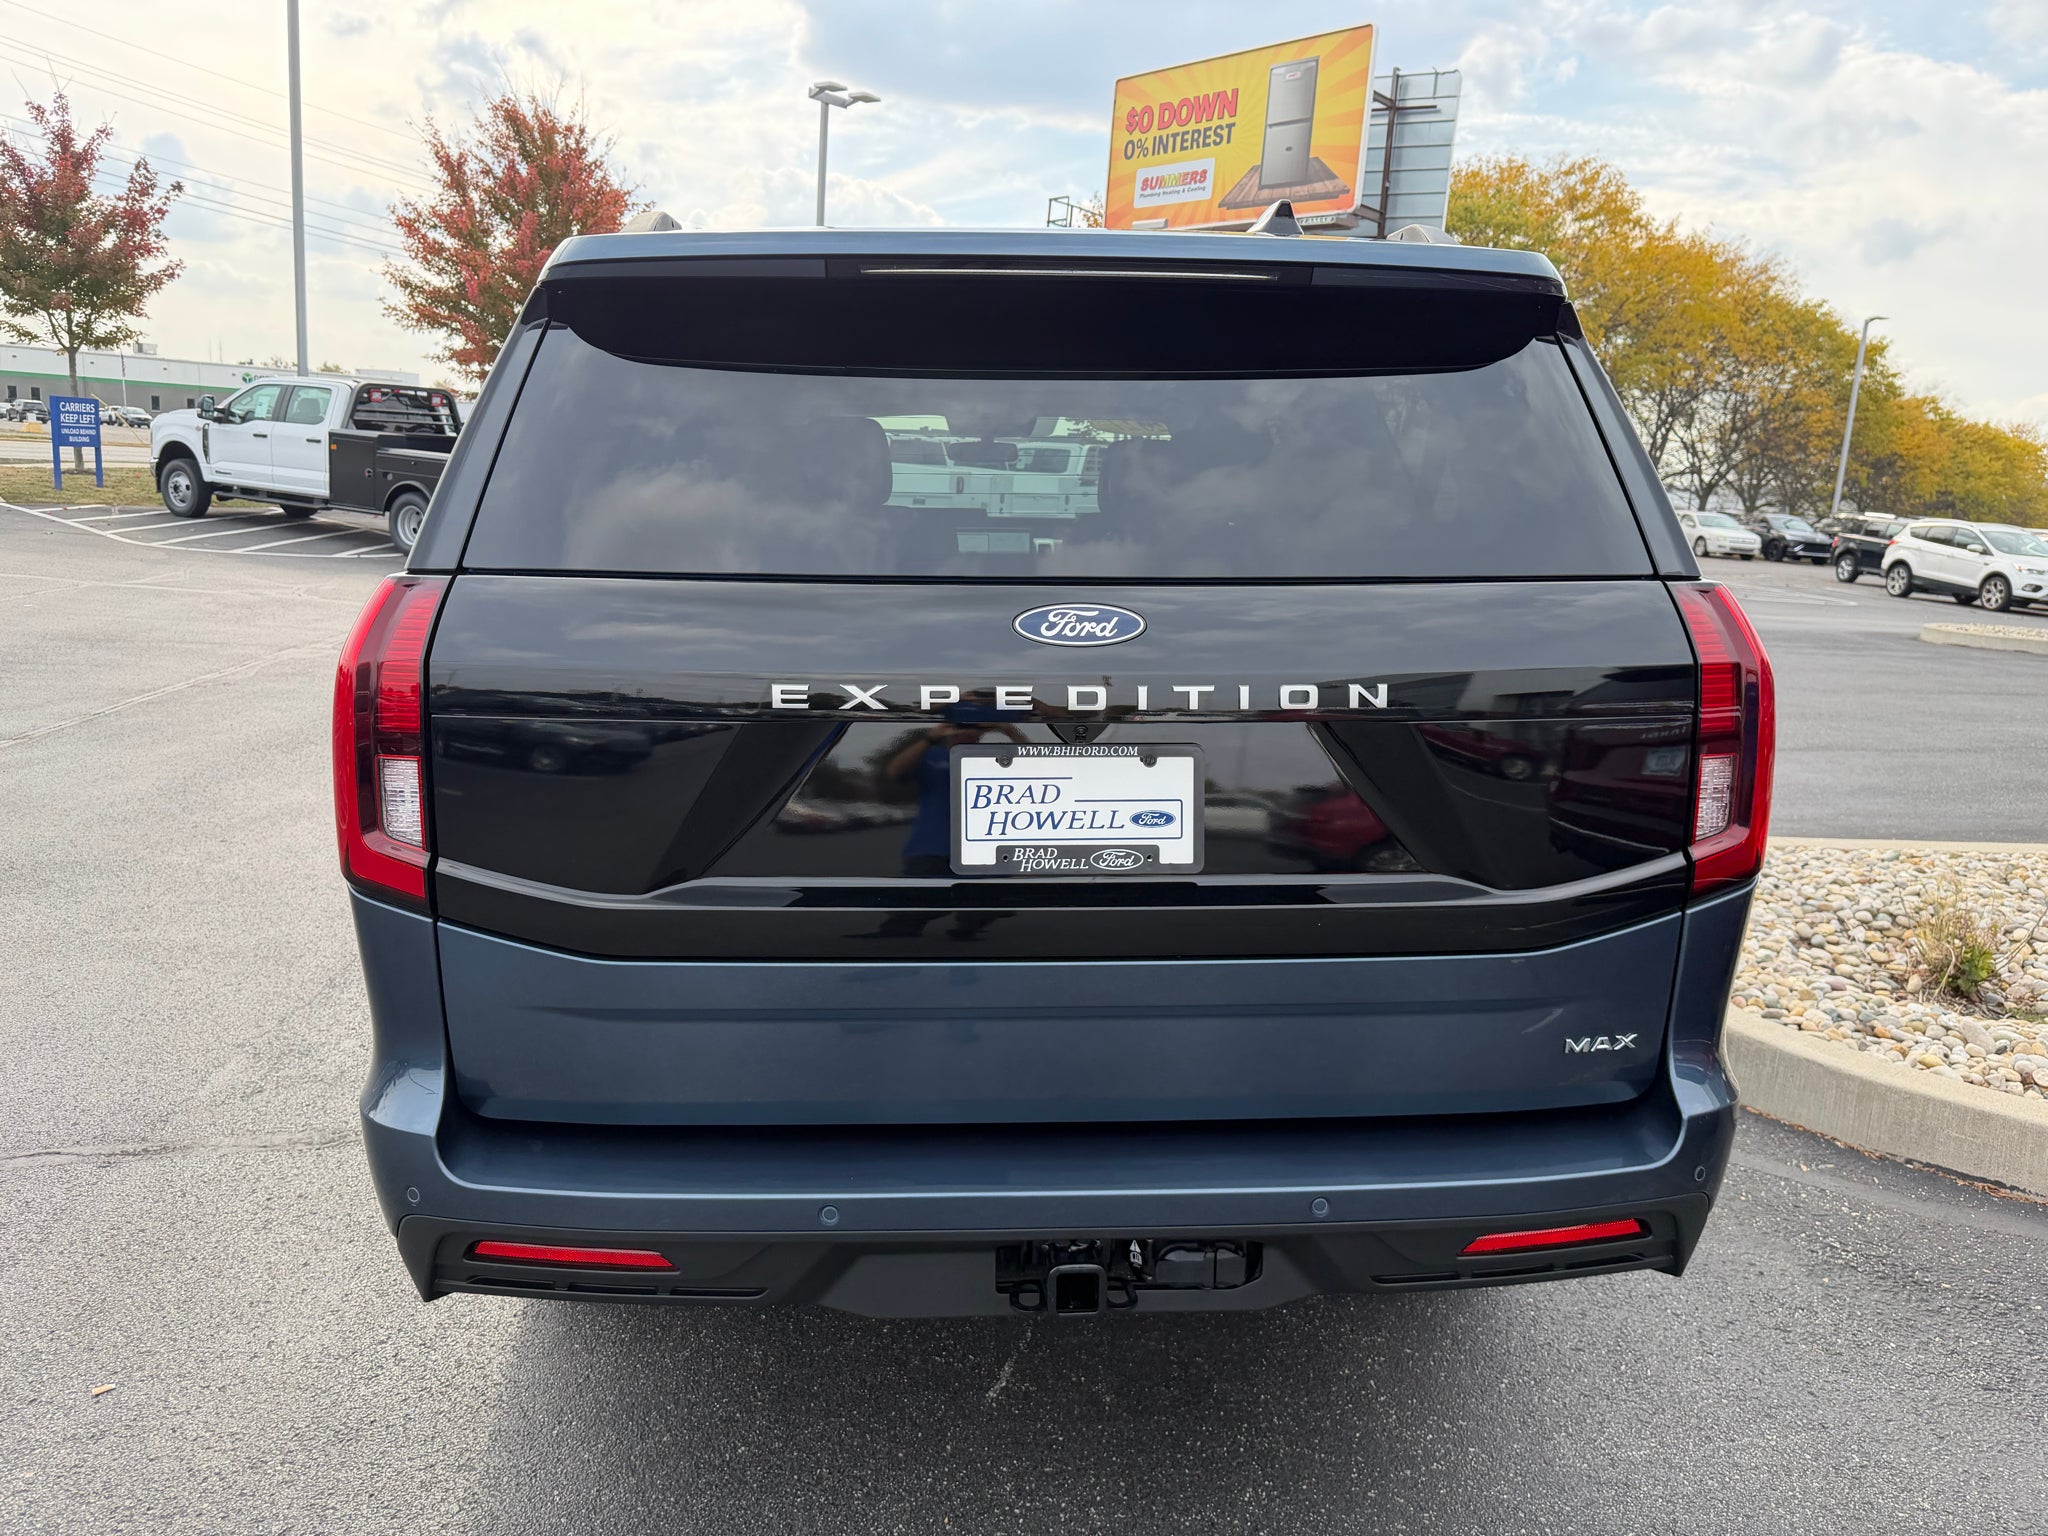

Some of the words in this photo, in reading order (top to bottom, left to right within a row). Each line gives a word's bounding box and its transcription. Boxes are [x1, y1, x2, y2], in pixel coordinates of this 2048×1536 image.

[1125, 105, 1154, 135] $0
[1157, 88, 1239, 130] DOWN
[1124, 137, 1149, 160] 0%
[1152, 122, 1236, 156] INTEREST
[1141, 169, 1208, 192] SUMMERS
[59, 401, 96, 413] CARRIERS
[60, 413, 79, 423] KEEP
[79, 414, 96, 424] LEFT
[1040, 609, 1119, 637] Ford
[771, 683, 1388, 711] EXPEDITION
[1017, 746, 1139, 756] WWW.BHIFORD.COM
[970, 784, 1061, 809] BRAD
[984, 810, 1125, 836] HOWELL
[1138, 812, 1167, 825] Ford
[1012, 847, 1058, 861] BRAD
[1020, 858, 1089, 872] HOWELL
[1099, 851, 1135, 867] Ford
[1564, 1033, 1638, 1054] MAX
